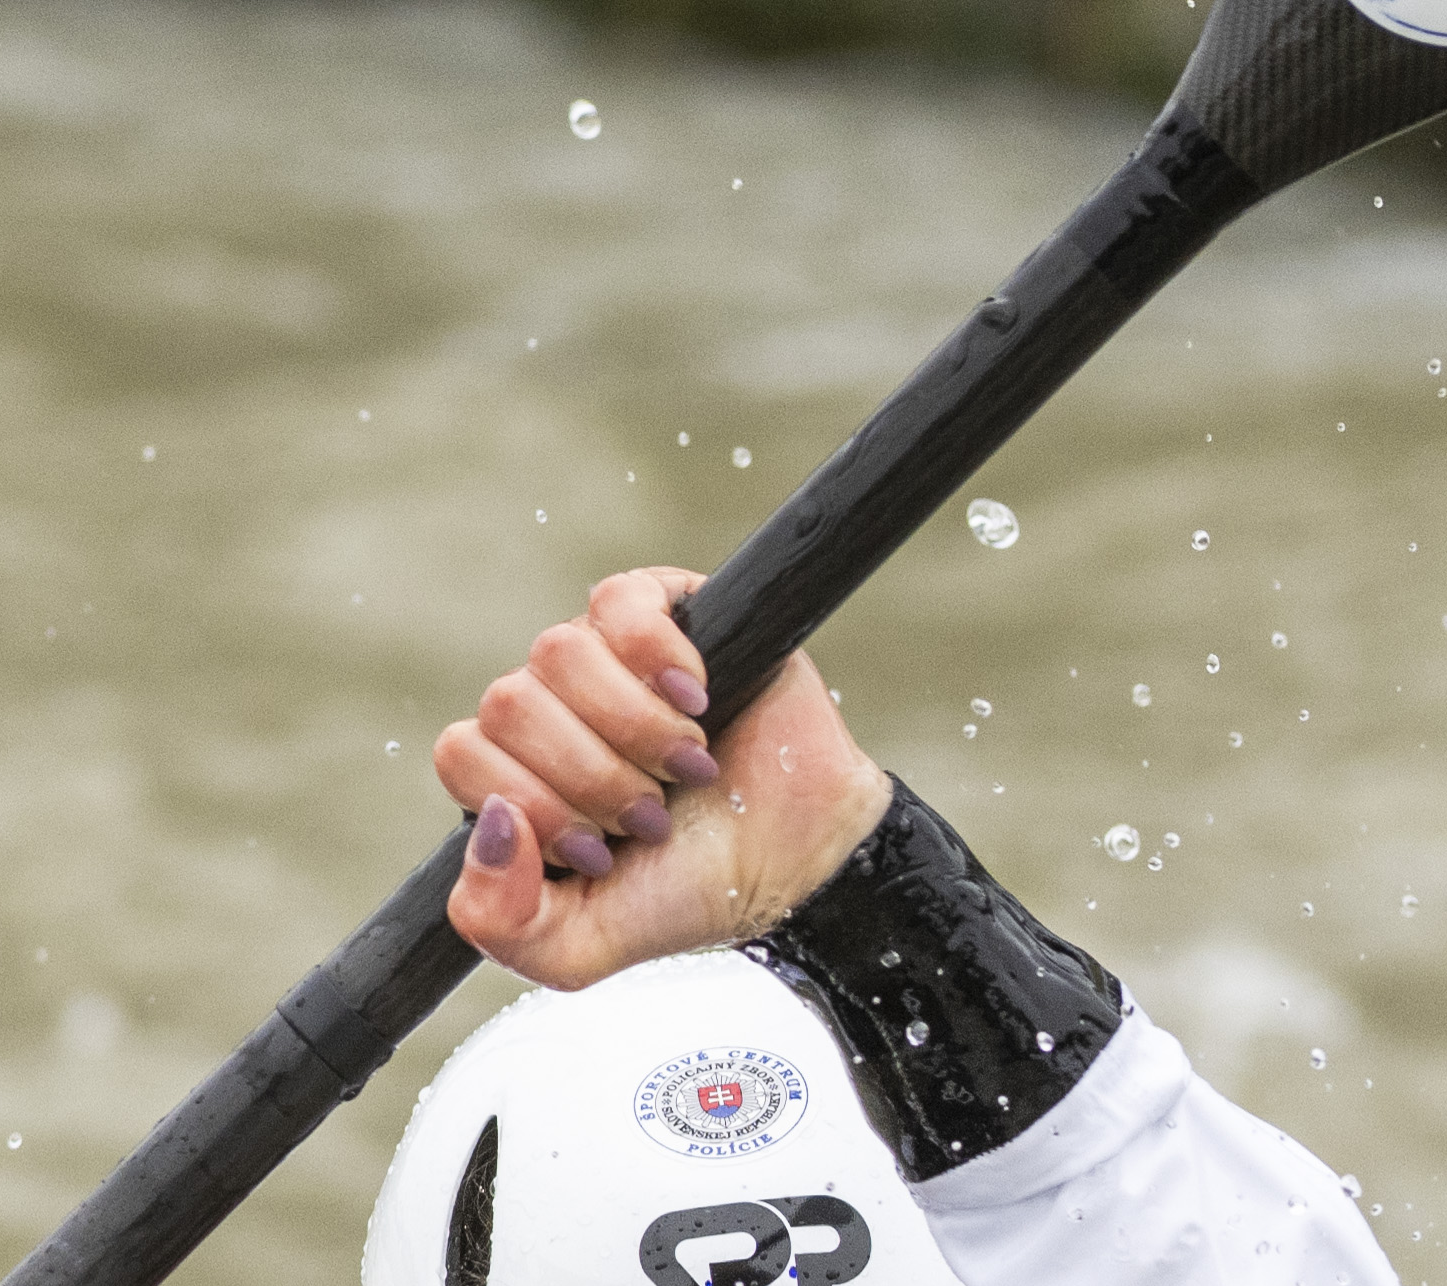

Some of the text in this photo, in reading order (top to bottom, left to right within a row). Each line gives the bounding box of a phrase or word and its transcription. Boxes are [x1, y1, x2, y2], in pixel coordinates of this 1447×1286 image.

[640, 1050, 803, 1121] ŠPORTOVÉ CENTRUM
[740, 1064, 774, 1086] ZBOR
[662, 1107, 732, 1139] SLOVENSKEJ
[686, 1133, 773, 1156] POLÍCIE
